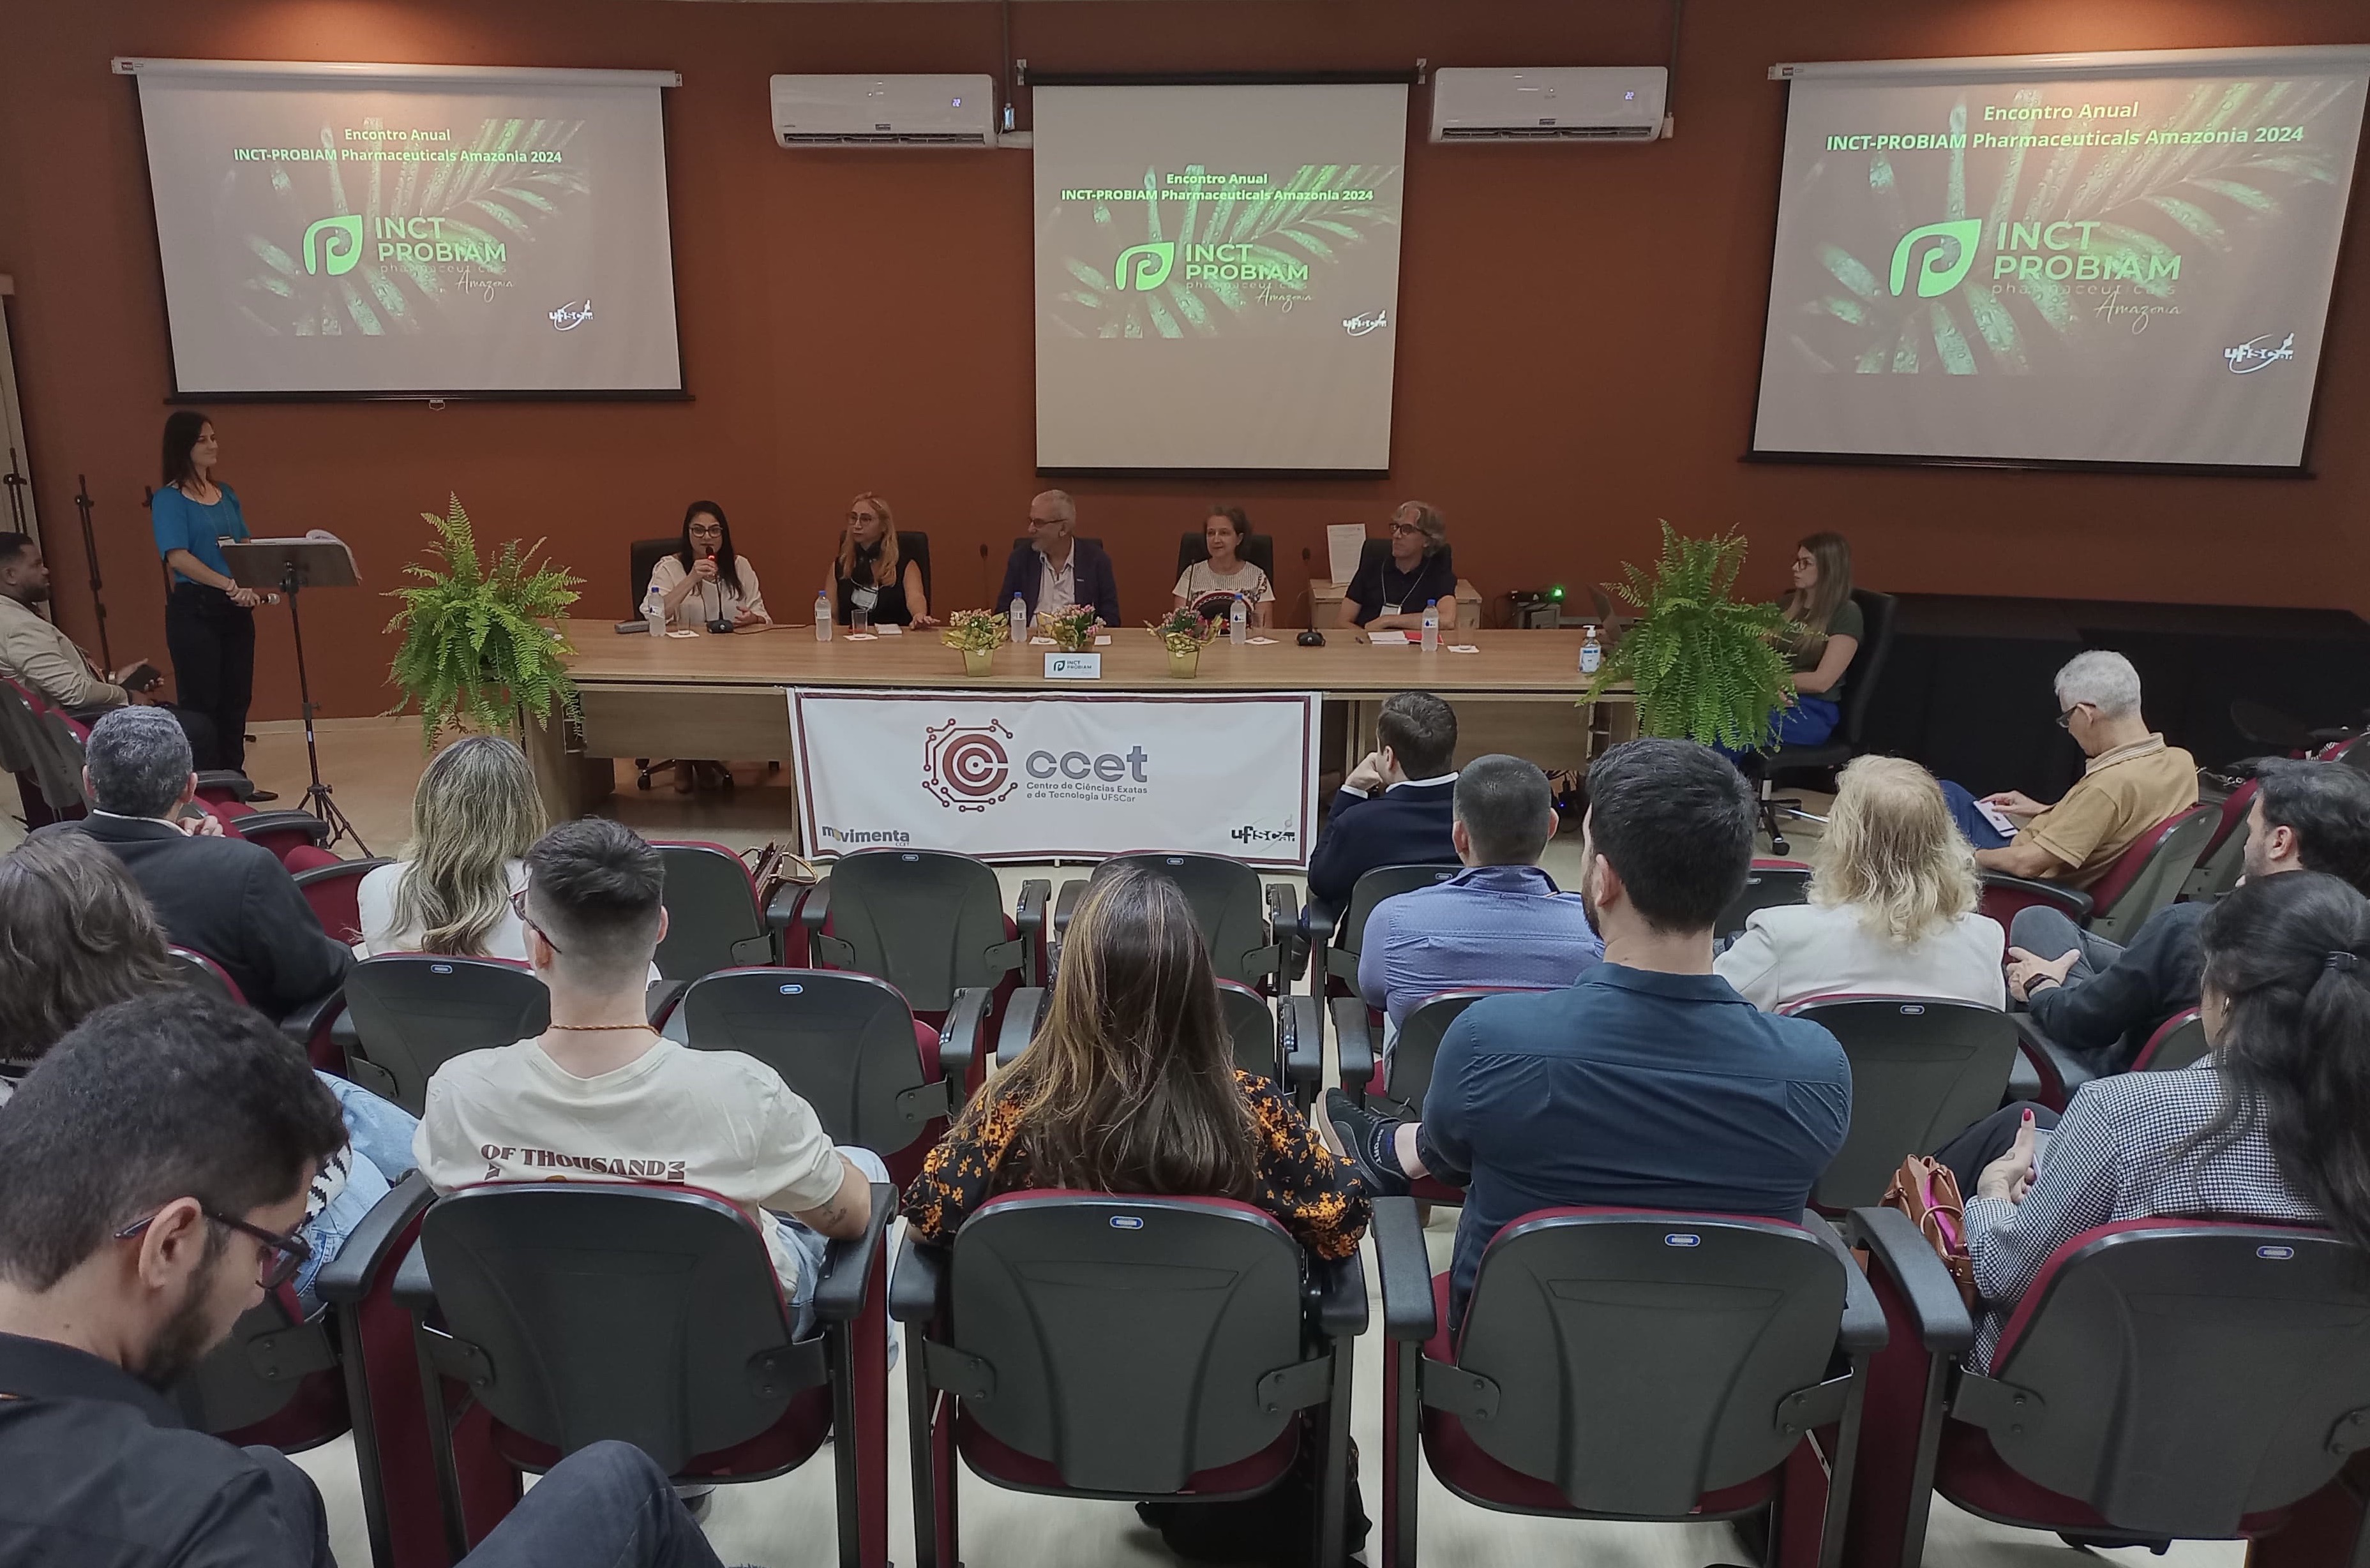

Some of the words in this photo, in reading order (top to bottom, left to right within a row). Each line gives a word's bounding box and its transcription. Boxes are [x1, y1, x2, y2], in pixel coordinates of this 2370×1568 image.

[1983, 105, 2073, 121] Encontro
[2078, 101, 2139, 119] Anual
[344, 128, 407, 140] Encontro
[410, 128, 451, 141] Anual
[1826, 133, 1967, 151] INCT-PROBIAM
[1972, 128, 2140, 149] Pharmaceuticals
[2253, 126, 2304, 143] 2024
[234, 149, 338, 161] INCT-PROBIAM
[341, 149, 457, 162] Pharmaceuticals
[530, 151, 562, 163] 2024
[1166, 173, 1226, 184] Encontro
[1229, 173, 1268, 184] Anual
[1061, 190, 1158, 201] INCT-PROBIAM
[1161, 190, 1272, 201] Pharmaceuticals
[1342, 191, 1374, 201] 2024
[375, 216, 446, 240] INCT
[1996, 221, 2100, 250] INCT
[378, 243, 507, 262] PROBIAM
[1185, 244, 1254, 263] INCT
[1185, 264, 1309, 281] PROBIAM
[1993, 255, 2182, 281] PROBIAM
[1026, 745, 1148, 782] ccet
[1049, 791, 1099, 801] Tecnologia
[1102, 794, 1136, 802] UFSCar
[1075, 782, 1114, 792] Ciências
[481, 1144, 516, 1160] OF
[521, 1149, 666, 1176] THOUSAND
